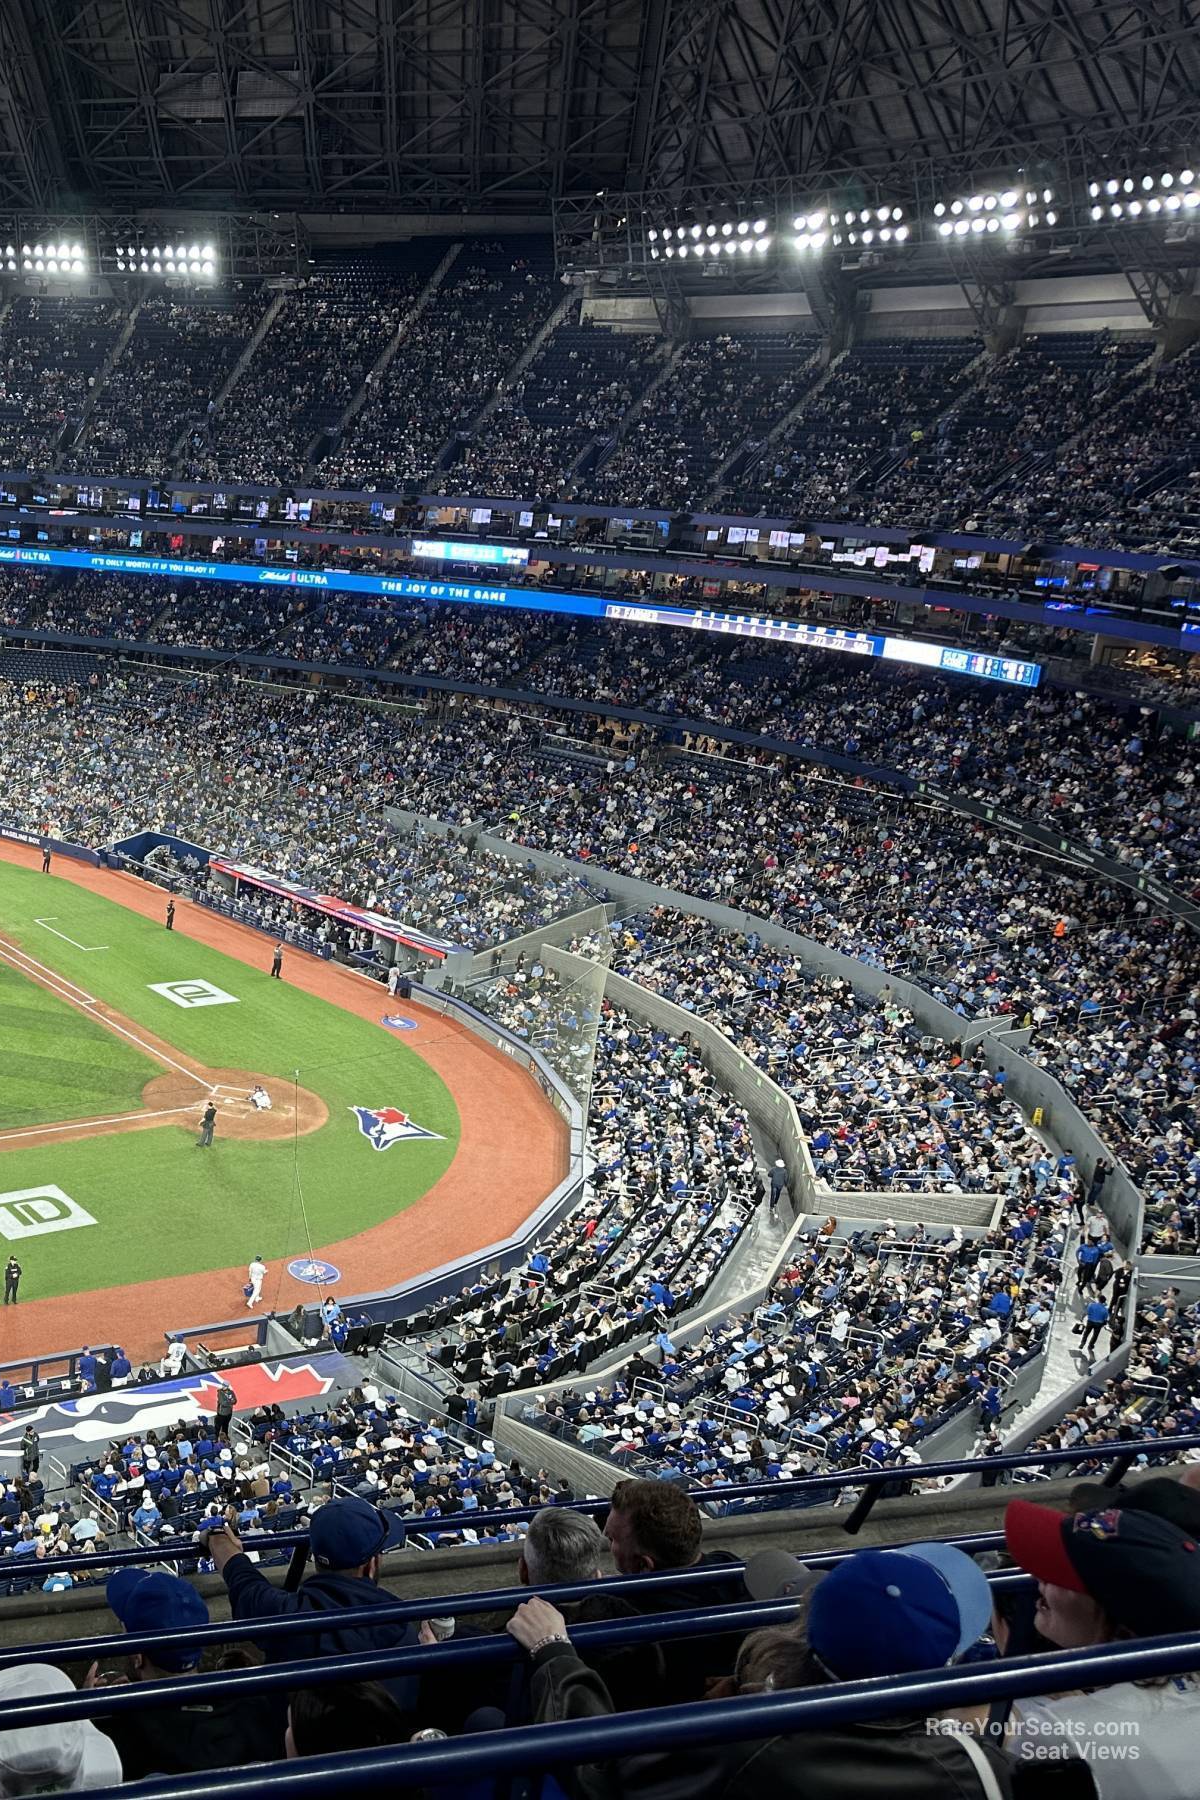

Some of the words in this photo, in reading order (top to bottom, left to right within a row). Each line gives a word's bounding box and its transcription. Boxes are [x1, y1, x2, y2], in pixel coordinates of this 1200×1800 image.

[21, 551, 50, 561] ULTRA
[106, 558, 124, 567] ONLY
[125, 559, 150, 569] WORTH
[169, 563, 183, 572] YOU
[184, 564, 207, 573] ENJOY
[297, 573, 328, 585] ULTRA
[382, 581, 402, 592] THE
[406, 583, 426, 595] JOY
[431, 585, 445, 596] OF
[449, 587, 470, 598] THE
[474, 589, 506, 602] GAME
[1, 828, 28, 842] BASELINE
[28, 836, 40, 845] BOX
[167, 983, 217, 1004] TD
